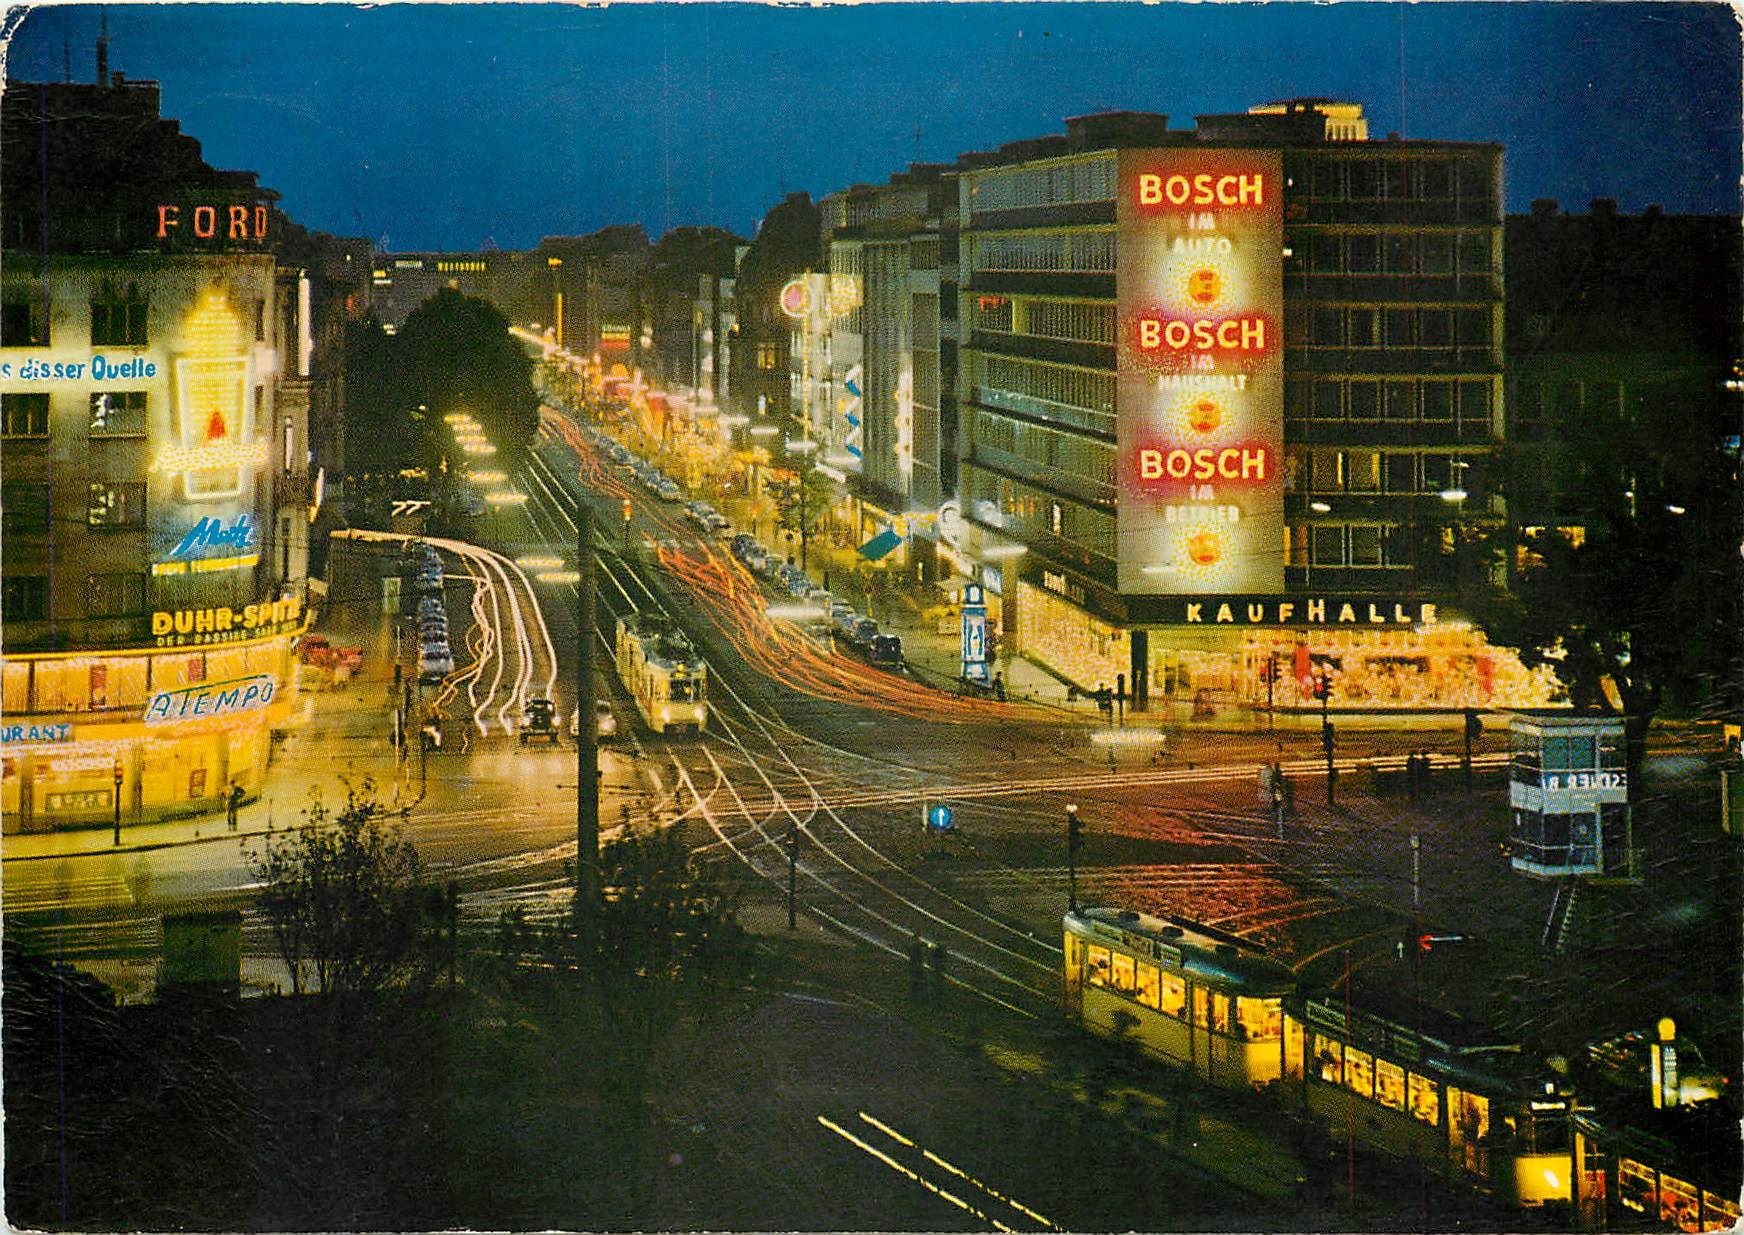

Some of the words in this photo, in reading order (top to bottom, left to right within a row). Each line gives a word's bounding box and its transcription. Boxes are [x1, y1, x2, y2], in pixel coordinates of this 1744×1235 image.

[1139, 174, 1263, 205] BOSCH
[157, 204, 268, 239] FORD
[1189, 212, 1215, 230] IM
[1172, 237, 1231, 254] AUTO
[1140, 319, 1265, 349] BOSCH
[1140, 449, 1265, 479] BOSCH
[1187, 599, 1438, 624] KAUFHALLE
